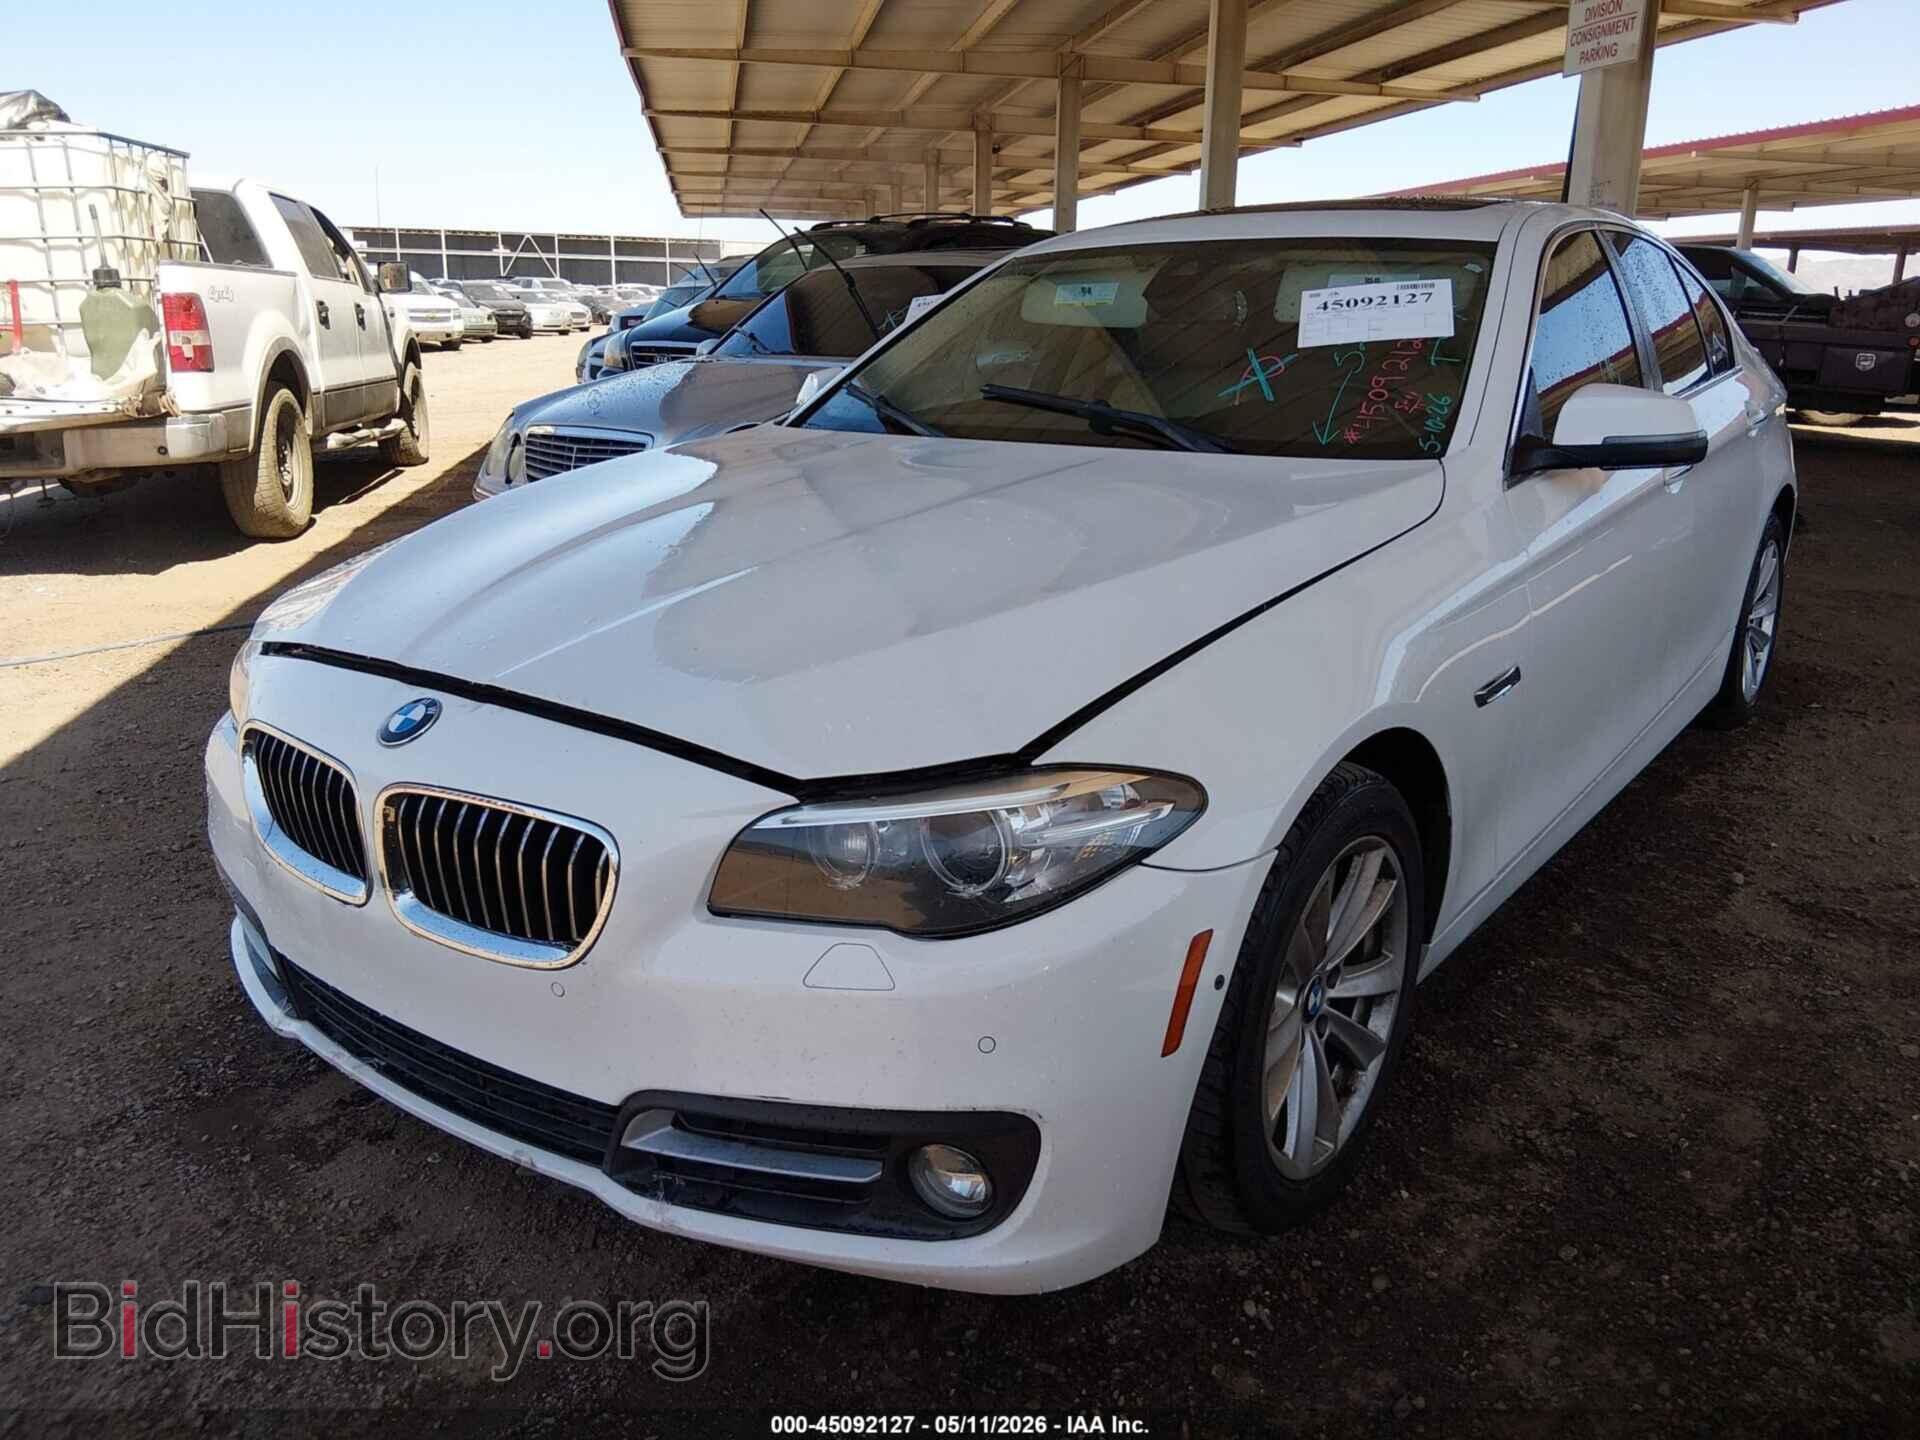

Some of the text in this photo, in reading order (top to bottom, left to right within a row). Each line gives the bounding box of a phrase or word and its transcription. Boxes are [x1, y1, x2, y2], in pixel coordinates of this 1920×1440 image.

[1585, 0, 1623, 22] DIVISION
[1570, 16, 1637, 47] CONSIGNMENT
[1579, 42, 1618, 65] PARKING
[1316, 292, 1433, 312] 45092127
